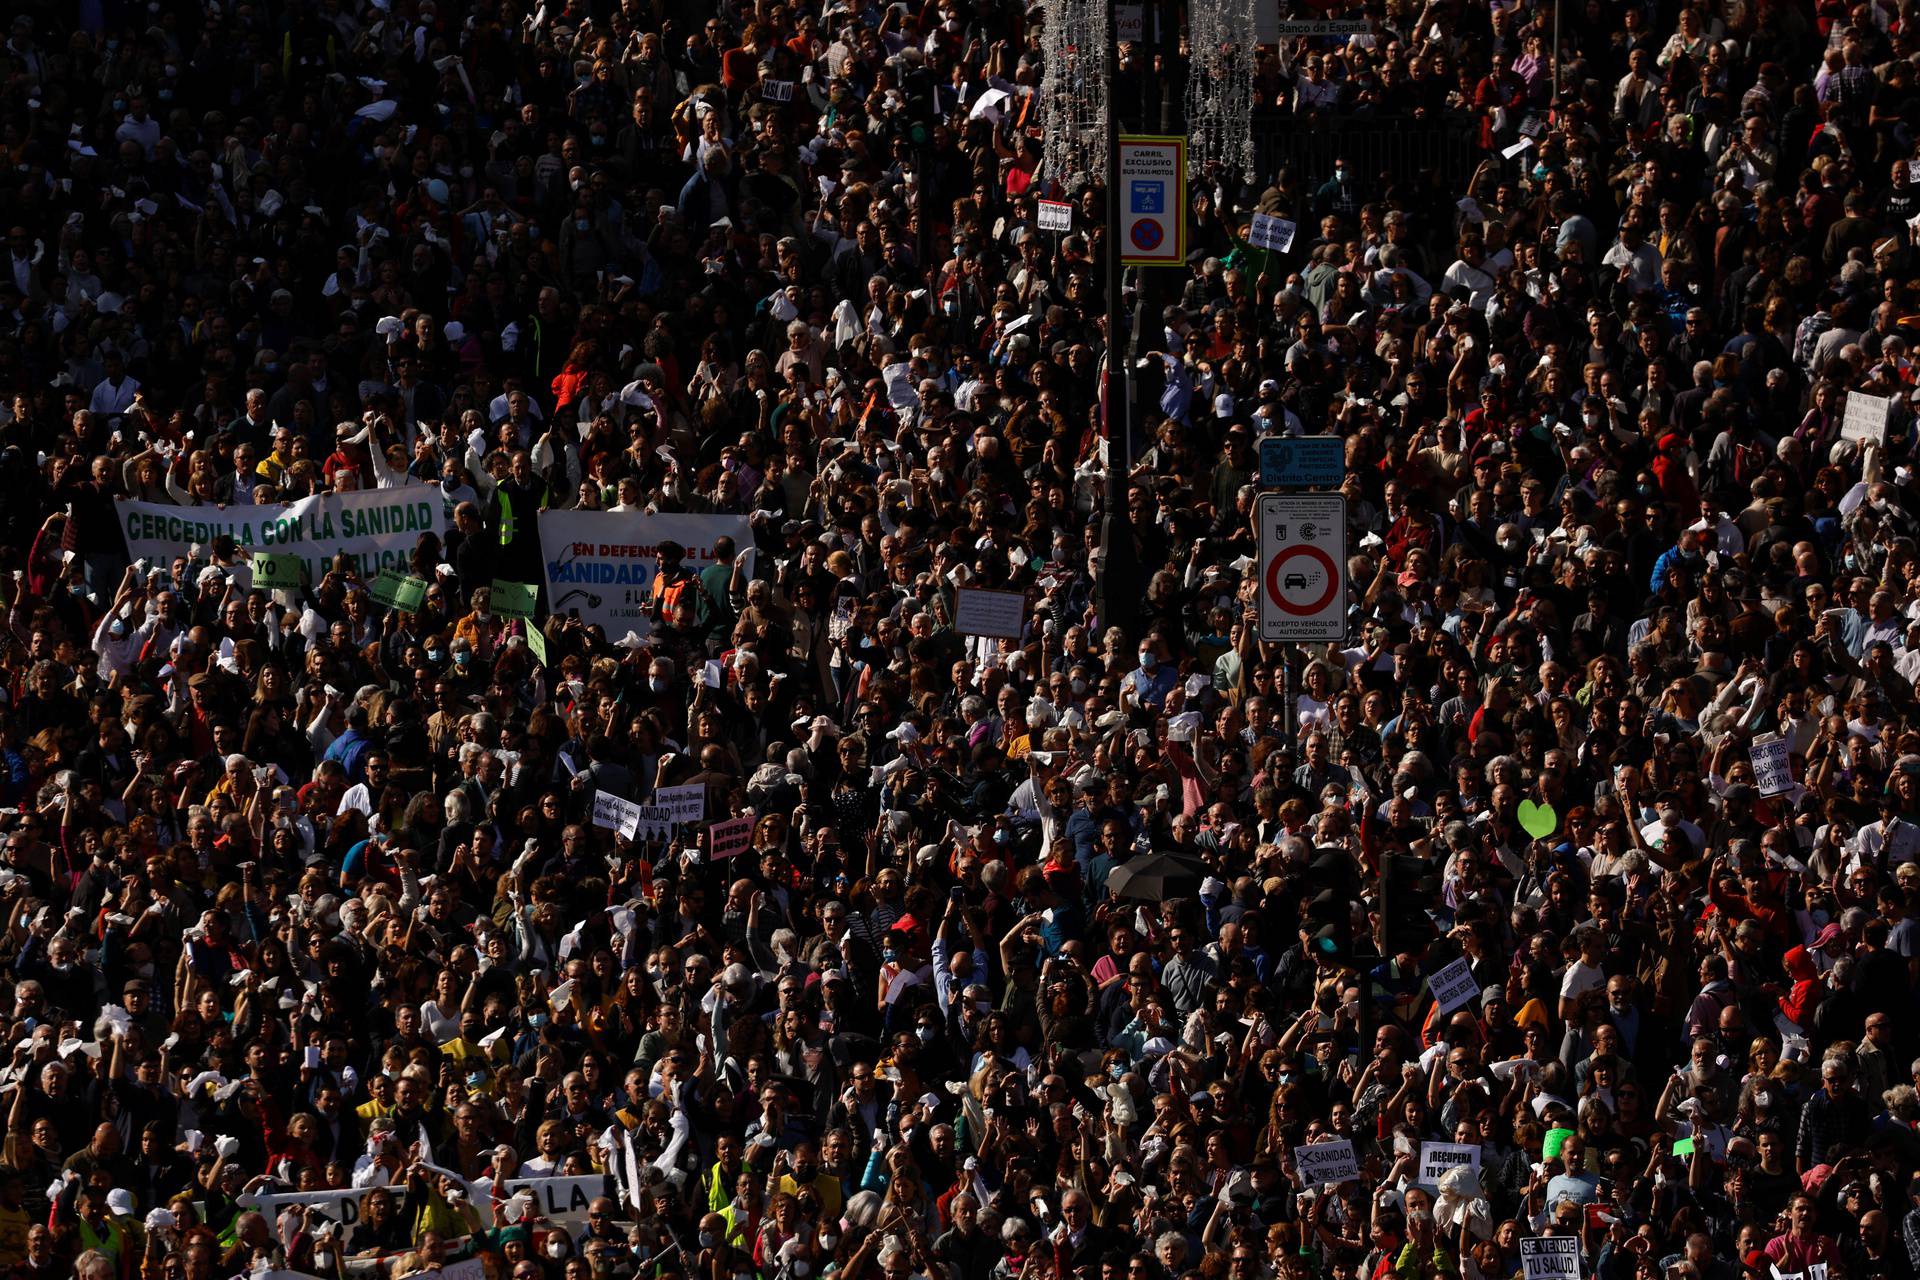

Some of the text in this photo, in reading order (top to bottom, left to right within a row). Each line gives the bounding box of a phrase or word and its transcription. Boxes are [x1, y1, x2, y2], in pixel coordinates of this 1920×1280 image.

[1279, 22, 1368, 35] Banco de España
[780, 84, 793, 100] NO
[1269, 223, 1293, 237] AYUSO
[1266, 472, 1341, 482] Distrito Centro
[262, 517, 303, 546] CON
[311, 511, 336, 541] LA
[341, 502, 433, 538] SANIDAD
[573, 543, 595, 556] EN
[599, 545, 659, 559] DEFENS
[256, 560, 276, 575] YO
[548, 561, 648, 586] SANIDAD
[1751, 743, 1787, 760] RECORTES
[1760, 774, 1790, 790] MATAN
[1430, 1151, 1472, 1164] ¡RECUPERA
[1426, 1166, 1436, 1178] TU
[547, 1184, 590, 1214] LA
[1522, 1240, 1575, 1254] SE VENDE
[1527, 1256, 1577, 1275] TU SALUD.
